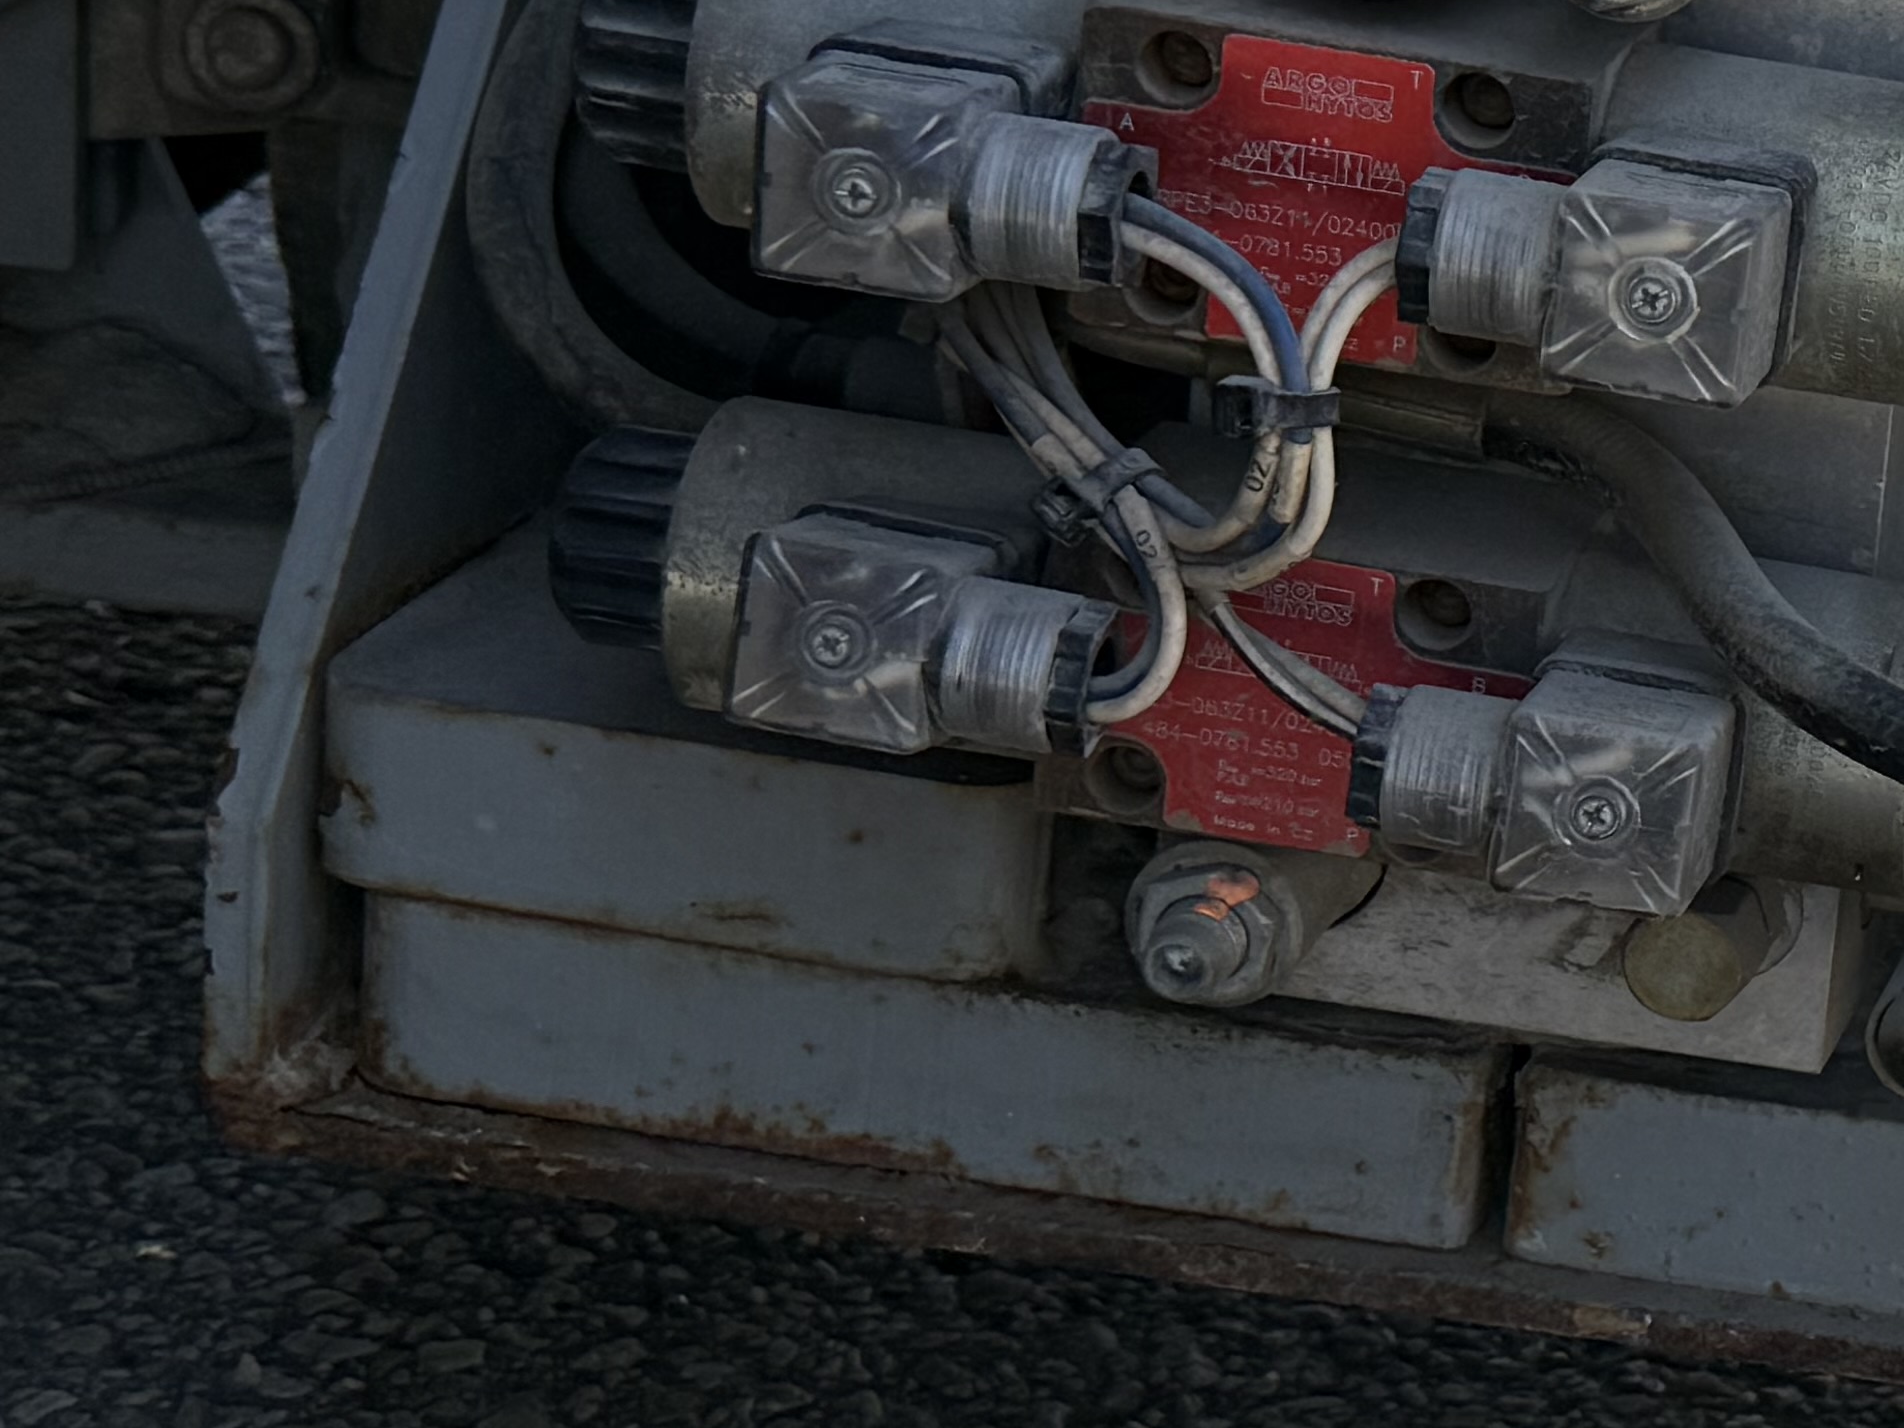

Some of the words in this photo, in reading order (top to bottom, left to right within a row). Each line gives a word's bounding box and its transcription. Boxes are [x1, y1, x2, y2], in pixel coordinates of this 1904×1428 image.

[1262, 66, 1351, 97] ARGO
[1410, 70, 1424, 91] T
[1305, 92, 1394, 124] HYTOS
[1118, 111, 1135, 133] A
[1392, 335, 1407, 353] P
[1370, 577, 1384, 597] T
